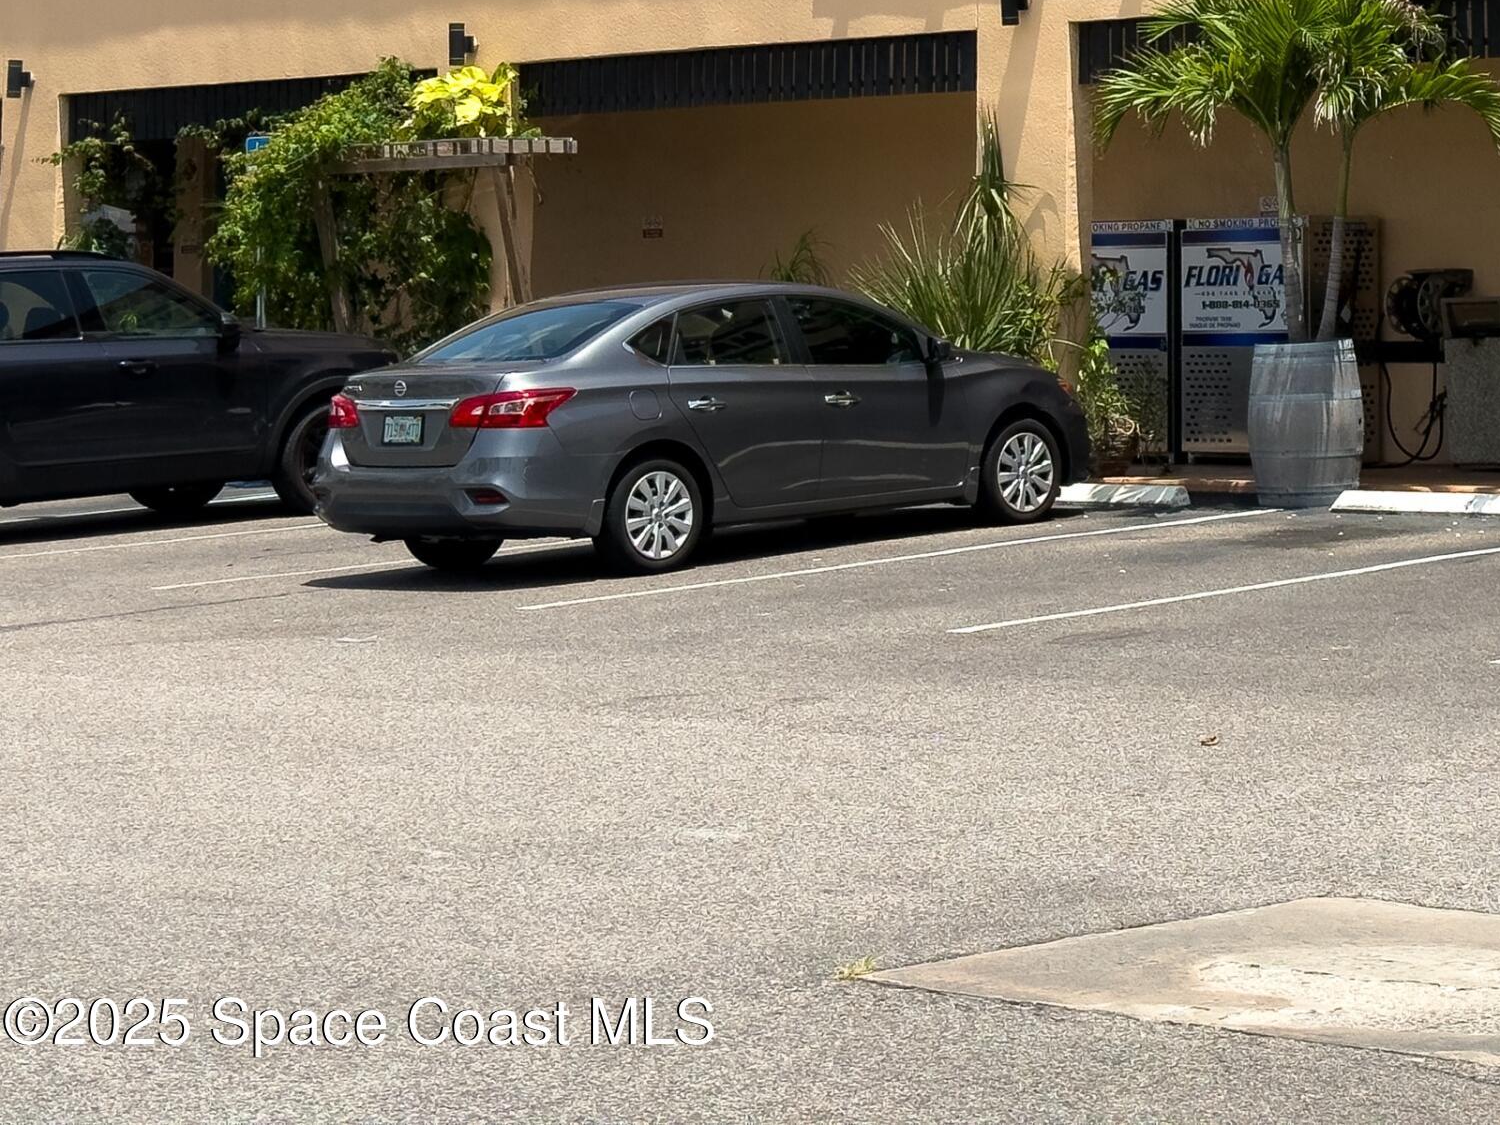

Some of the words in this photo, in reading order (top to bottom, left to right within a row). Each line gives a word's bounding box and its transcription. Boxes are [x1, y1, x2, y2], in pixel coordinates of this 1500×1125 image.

[1092, 222, 1119, 232] OKING
[1121, 221, 1163, 231] PROPANE
[1198, 220, 1210, 228] NO
[1213, 219, 1254, 228] SMOKING
[1123, 269, 1164, 292] GAS
[1184, 265, 1241, 288] FLORI
[1257, 263, 1285, 286] GA
